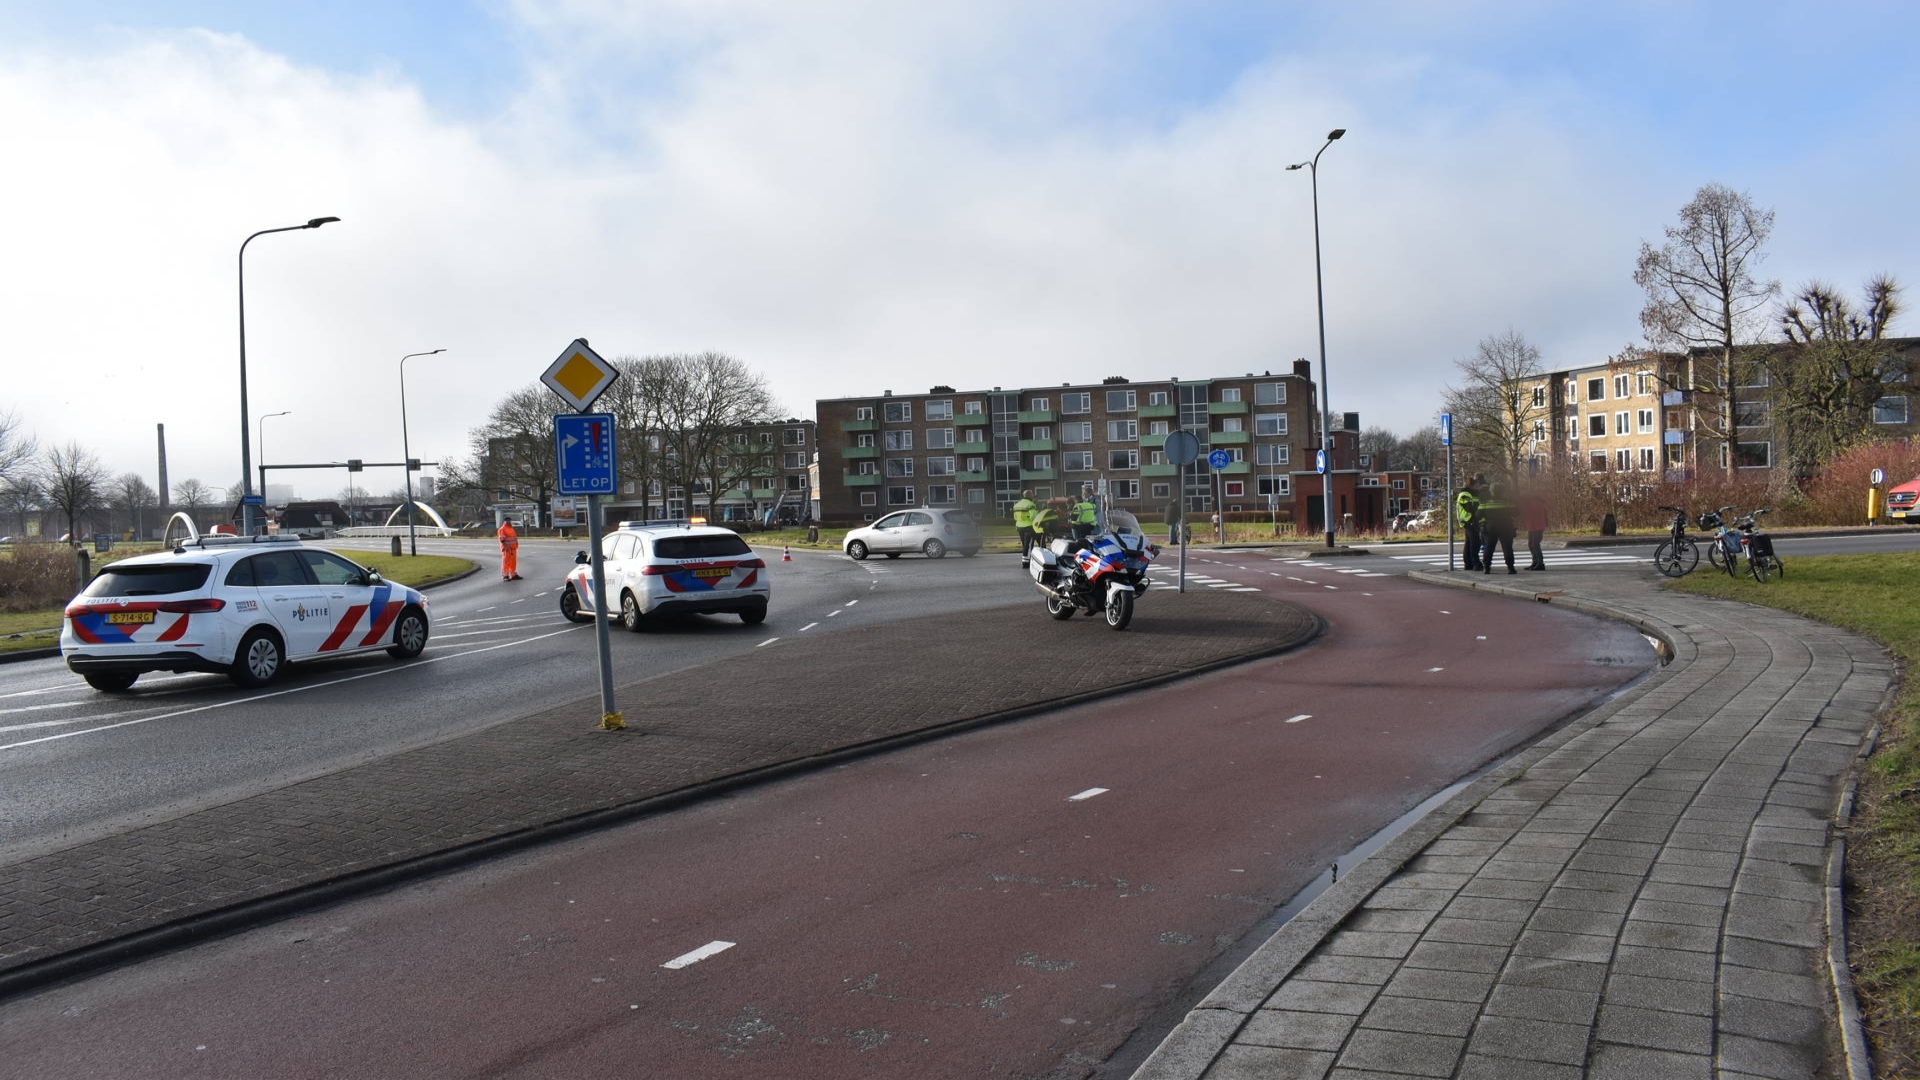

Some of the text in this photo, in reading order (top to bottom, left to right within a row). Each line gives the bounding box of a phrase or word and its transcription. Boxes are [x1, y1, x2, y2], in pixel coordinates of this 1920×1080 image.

[563, 477, 609, 488] LET OP
[246, 600, 257, 608] 112
[112, 613, 150, 623] S-714-RG
[292, 606, 329, 621] POLITIE
